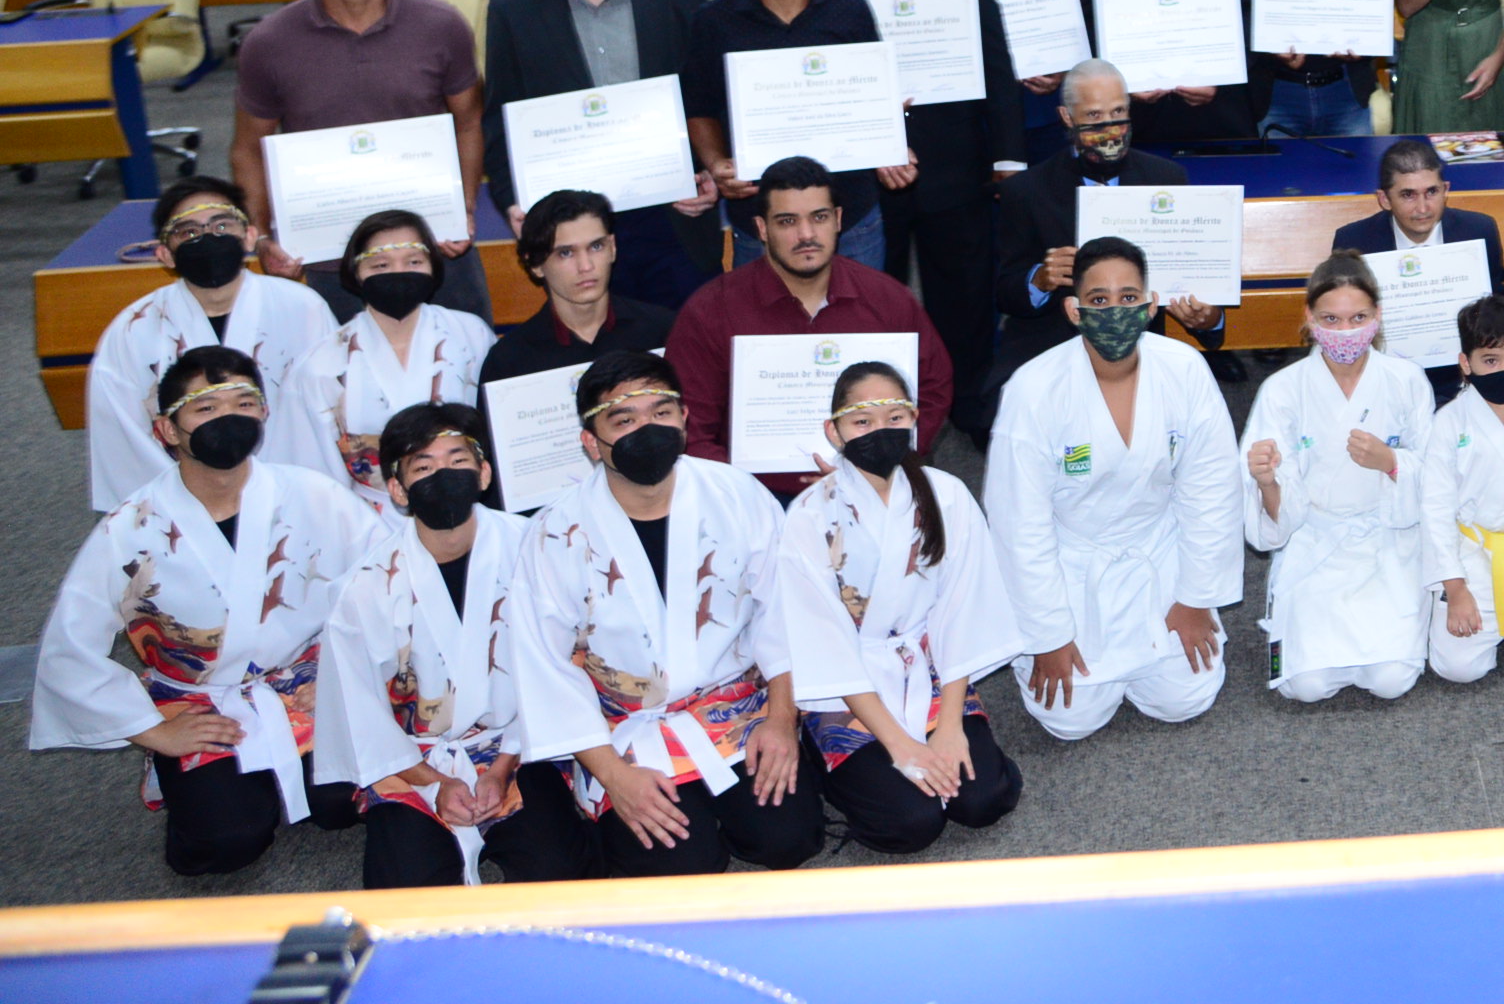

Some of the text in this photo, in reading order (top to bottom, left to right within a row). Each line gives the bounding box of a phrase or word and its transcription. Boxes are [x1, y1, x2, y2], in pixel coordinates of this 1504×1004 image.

[759, 369, 799, 380] Diploma
[802, 369, 811, 378] de
[517, 404, 558, 421] Diploma
